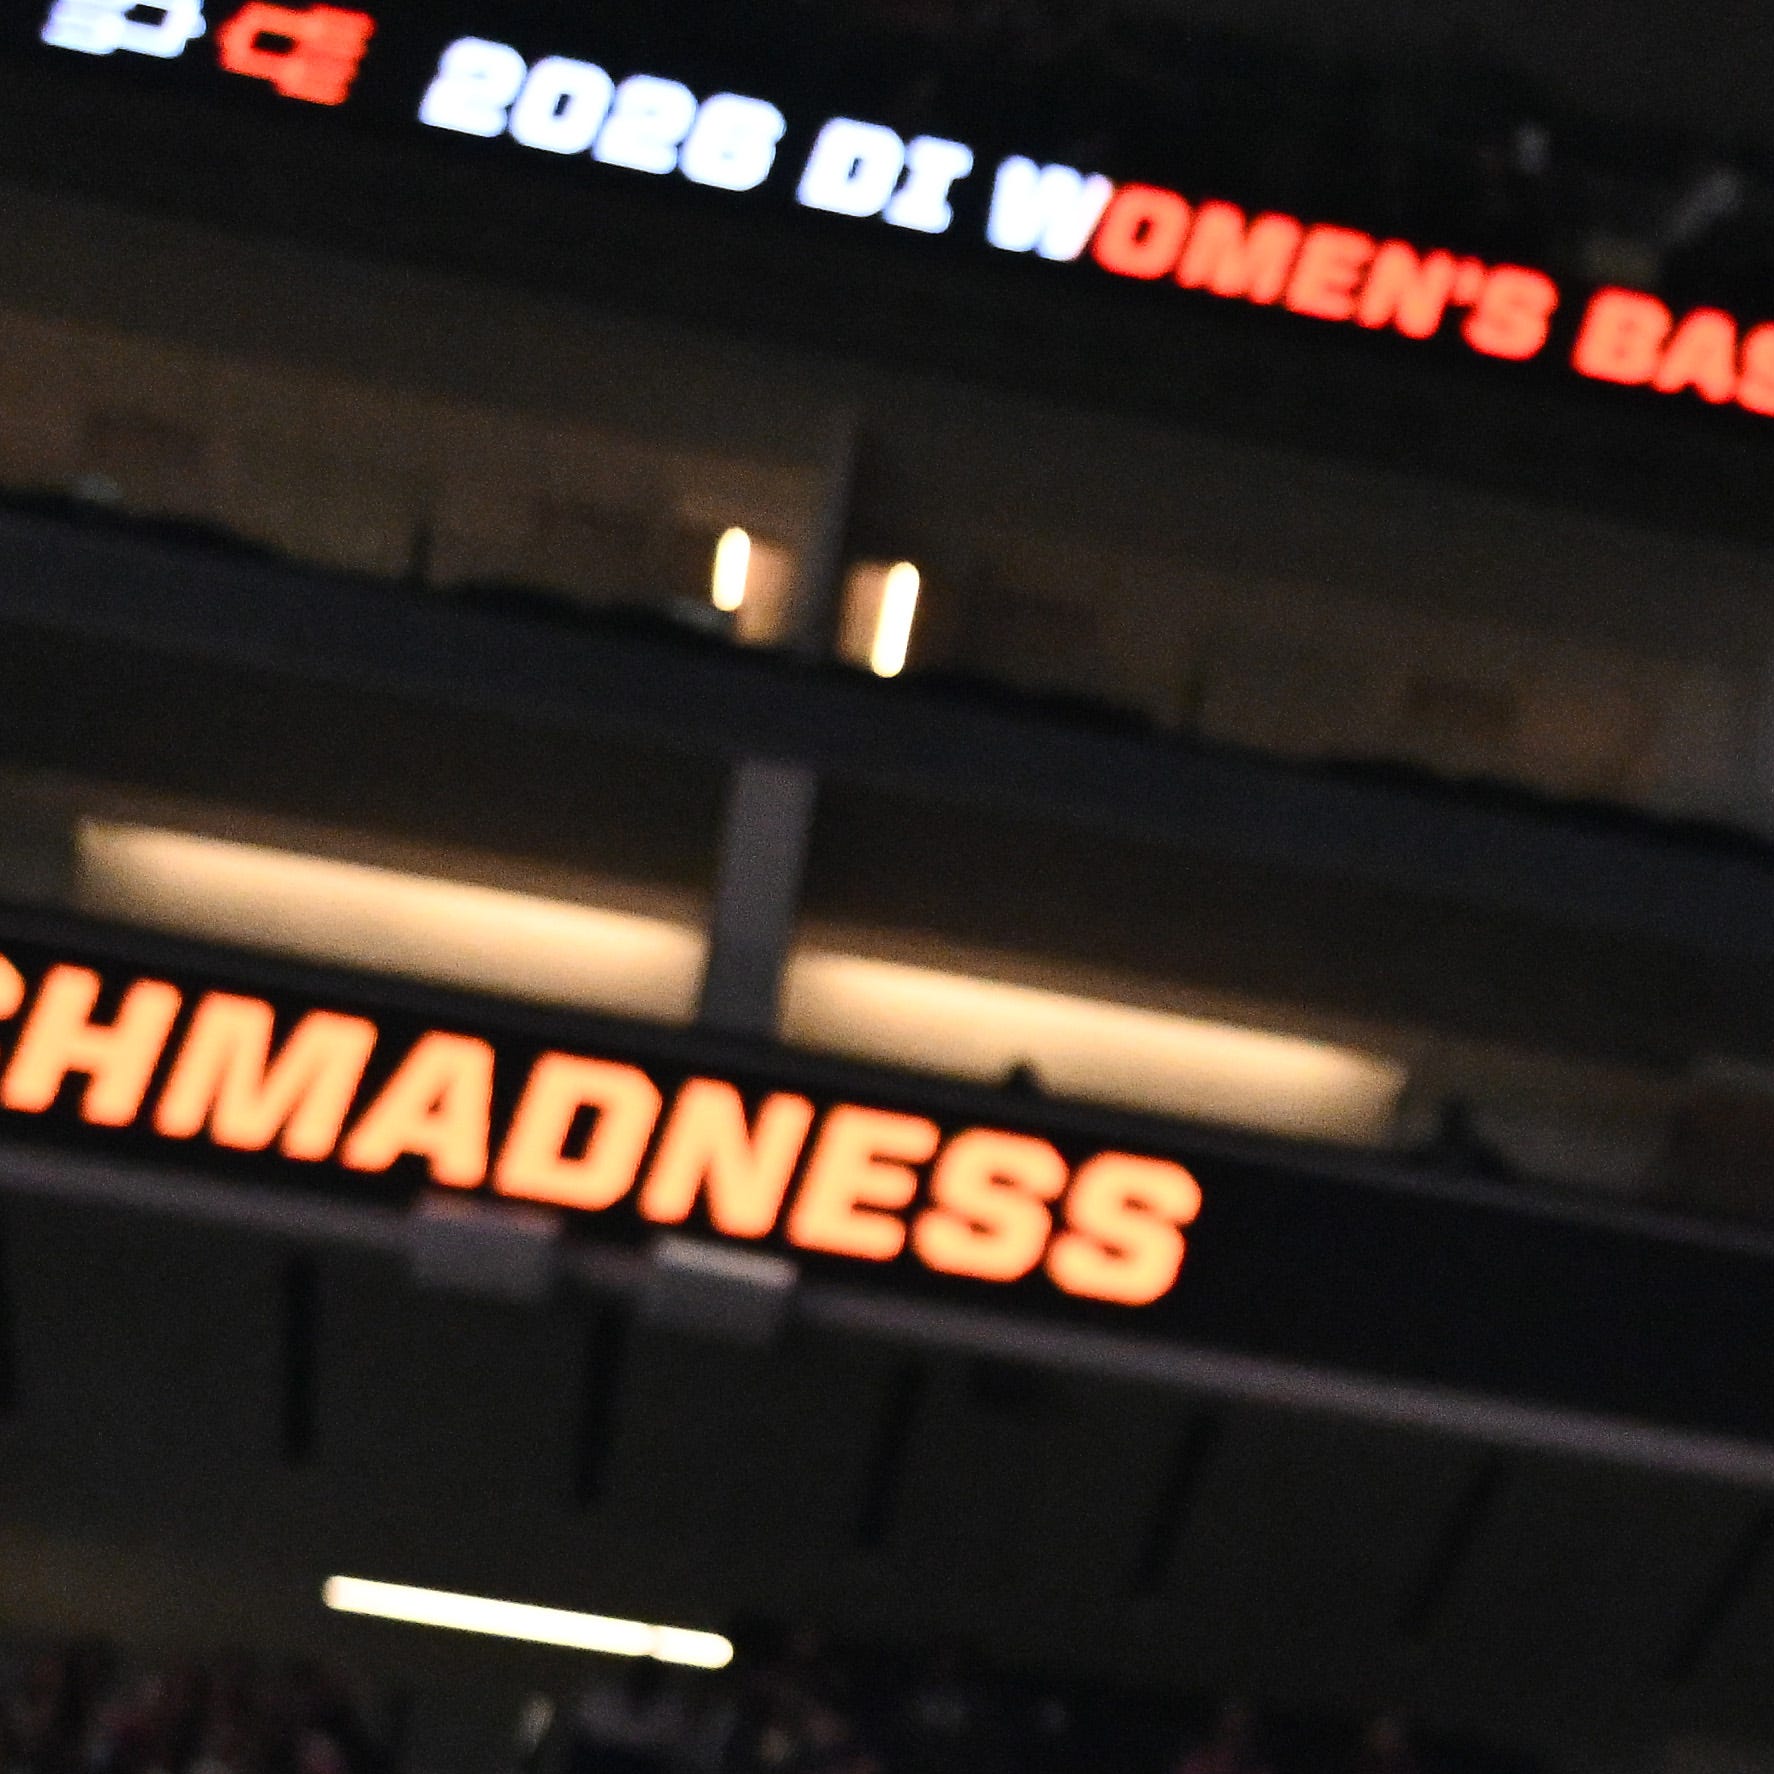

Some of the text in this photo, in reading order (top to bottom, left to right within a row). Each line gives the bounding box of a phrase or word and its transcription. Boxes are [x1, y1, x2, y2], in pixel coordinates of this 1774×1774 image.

[418, 36, 787, 191] 2026
[796, 117, 974, 233] DI
[986, 155, 1559, 361] WOMEN'S
[0, 953, 1203, 1306] HMADNESS
